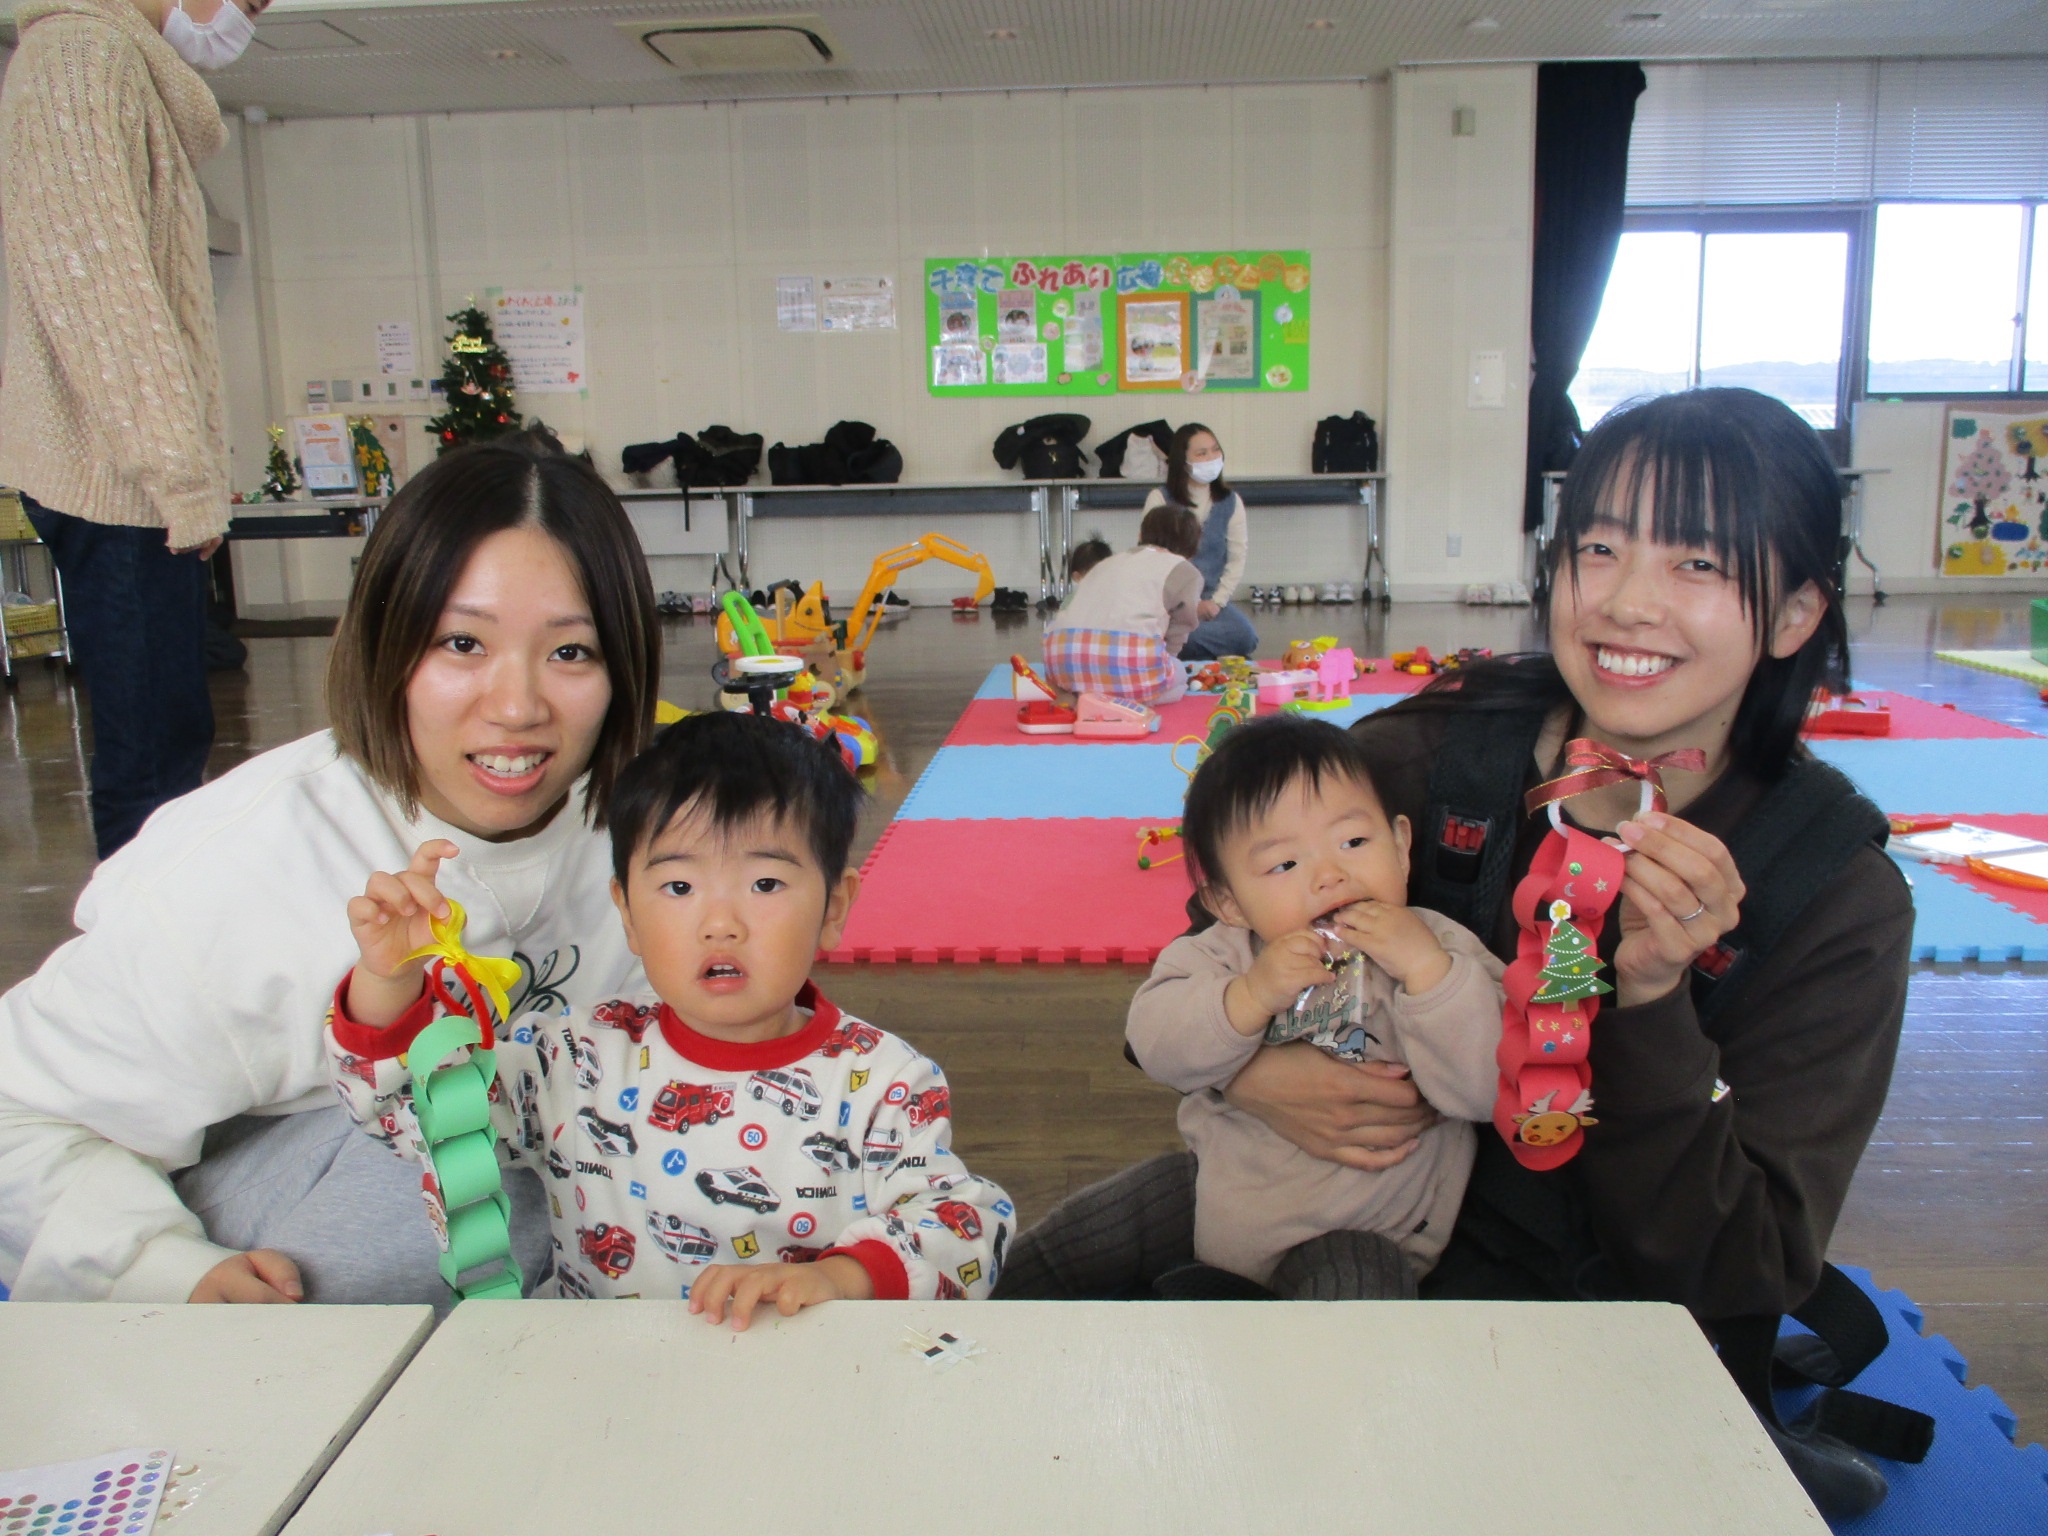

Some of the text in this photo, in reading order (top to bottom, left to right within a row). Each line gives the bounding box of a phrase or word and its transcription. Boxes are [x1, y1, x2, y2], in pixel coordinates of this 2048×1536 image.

[930, 262, 1003, 293] 子育て
[1012, 261, 1109, 293] ふれあい
[746, 1130, 760, 1143] 50
[575, 1160, 613, 1179] TOMIC
[796, 1185, 837, 1199] TOMICA
